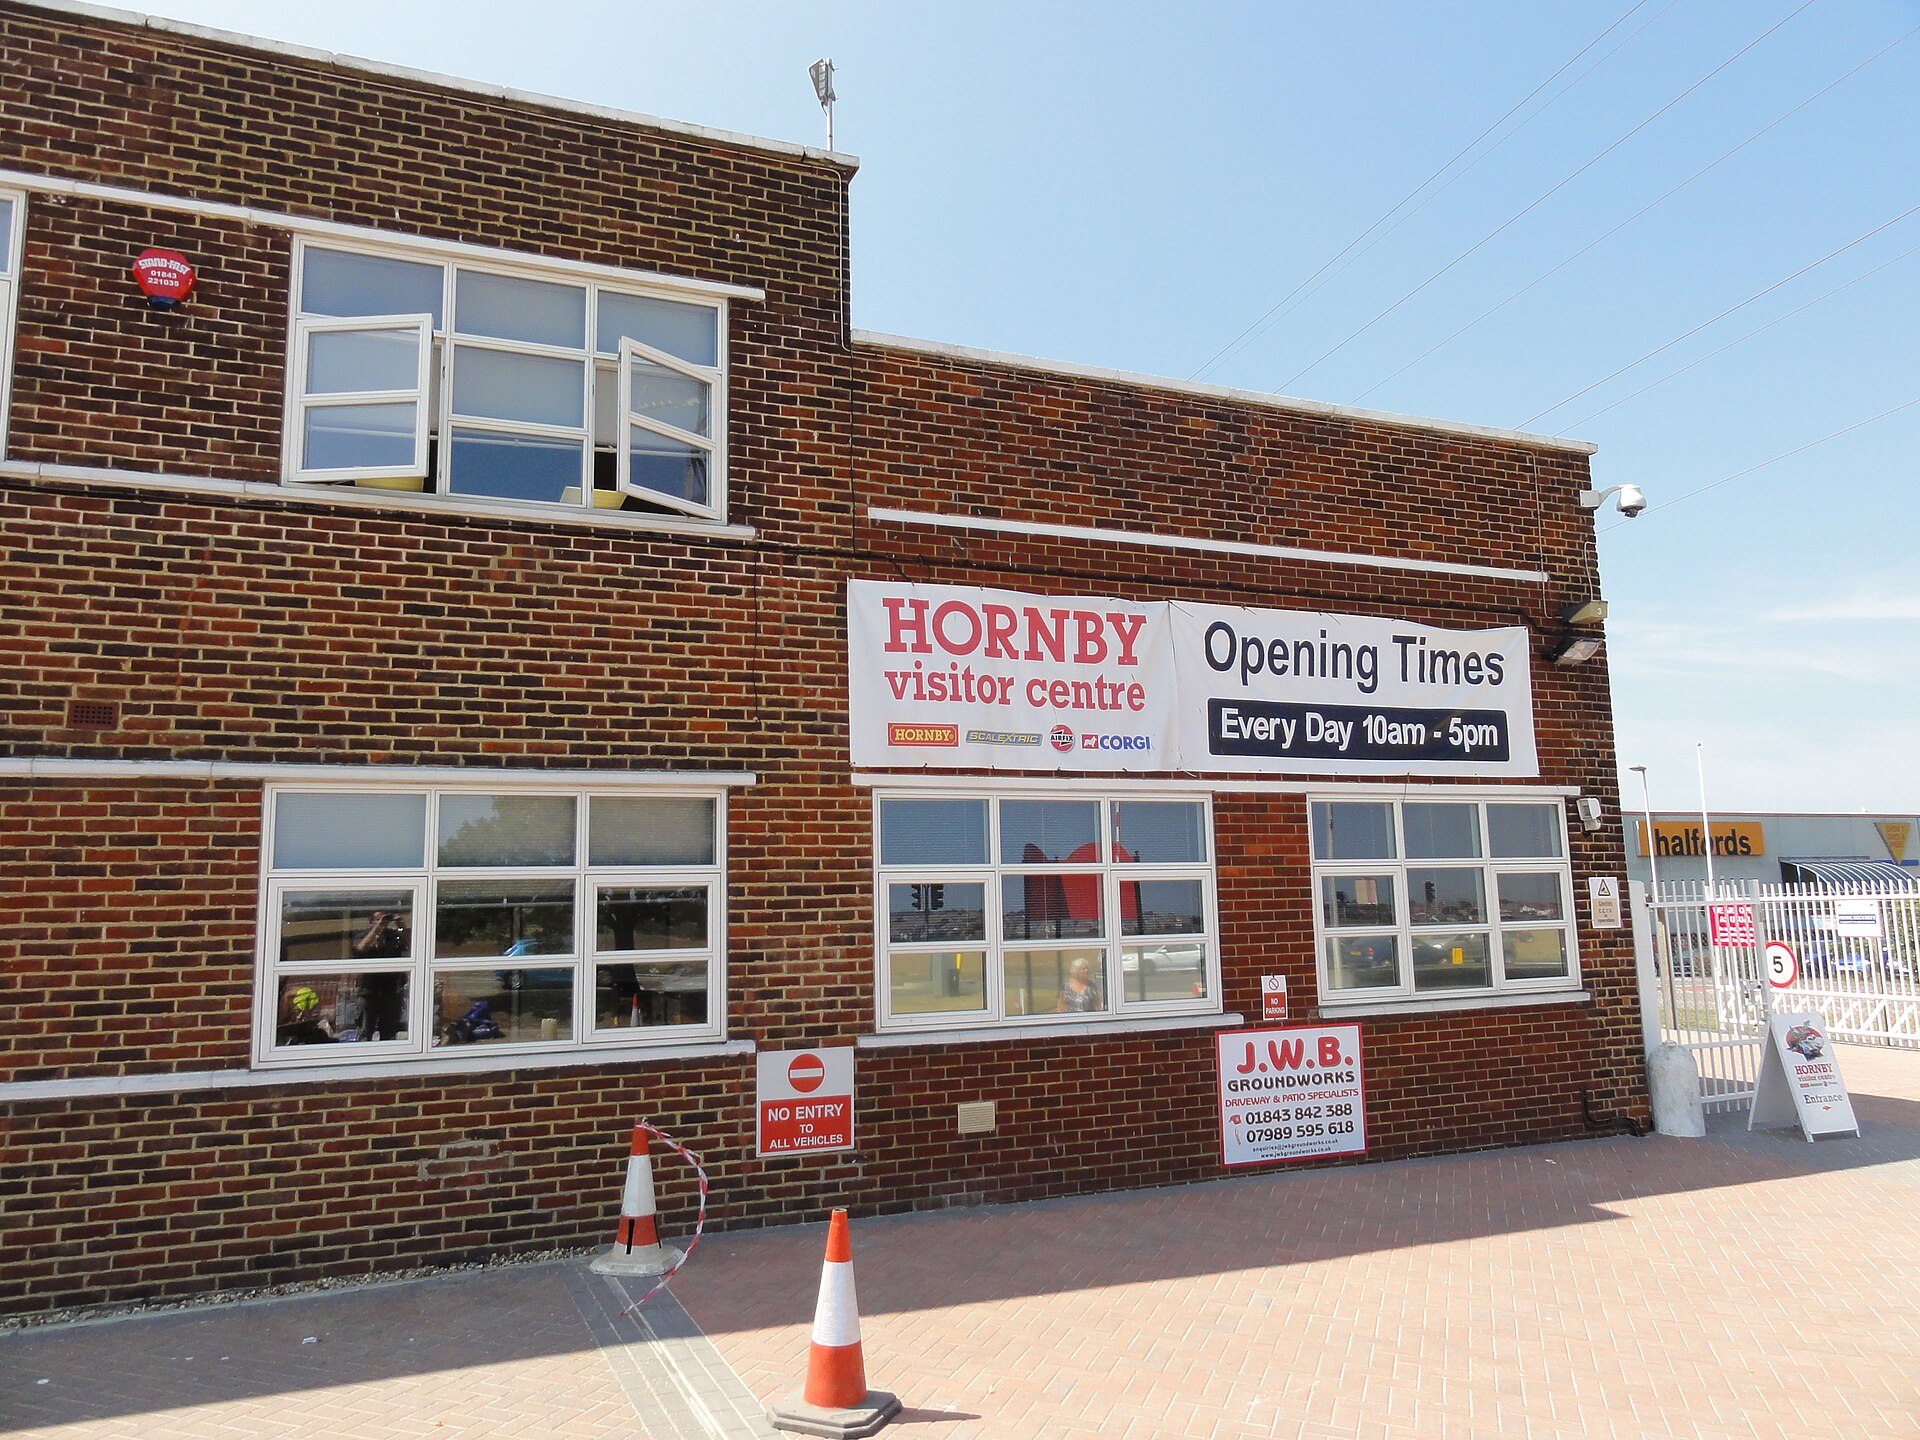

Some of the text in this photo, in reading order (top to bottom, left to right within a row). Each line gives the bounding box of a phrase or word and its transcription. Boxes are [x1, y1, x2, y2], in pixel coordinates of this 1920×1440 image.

[150, 270, 177, 279] 01843
[882, 597, 1147, 666] HORNBY
[1204, 620, 1505, 693] Opening Times
[884, 660, 1146, 712] visitor centre
[894, 728, 951, 742] HORNBY
[969, 732, 1039, 745] SCALEXTRIC
[1221, 707, 1296, 749] Every
[1305, 711, 1353, 751] Day
[1362, 714, 1425, 746] 10am
[1448, 717, 1499, 752] 5pm
[1099, 735, 1151, 750] CORGI
[1654, 828, 1752, 856] halfords
[1773, 955, 1784, 974] 5
[1265, 1006, 1286, 1015] PARKING
[1270, 997, 1279, 1005] NO
[1236, 1036, 1354, 1075] J.W.B.
[1794, 1063, 1833, 1075] HORNBY
[1227, 1071, 1355, 1093] GROUNDWORKS
[1225, 1088, 1359, 1108] DRIVEWAY & PATIO SPECIALISTS
[1803, 1093, 1843, 1104] Entrance
[768, 1103, 844, 1122] NO ENTRY
[1245, 1103, 1353, 1125] 01843 842 388
[799, 1123, 814, 1133] TO
[1246, 1120, 1354, 1143] 07989 595 618
[769, 1133, 843, 1149] ALL VEHICLES
